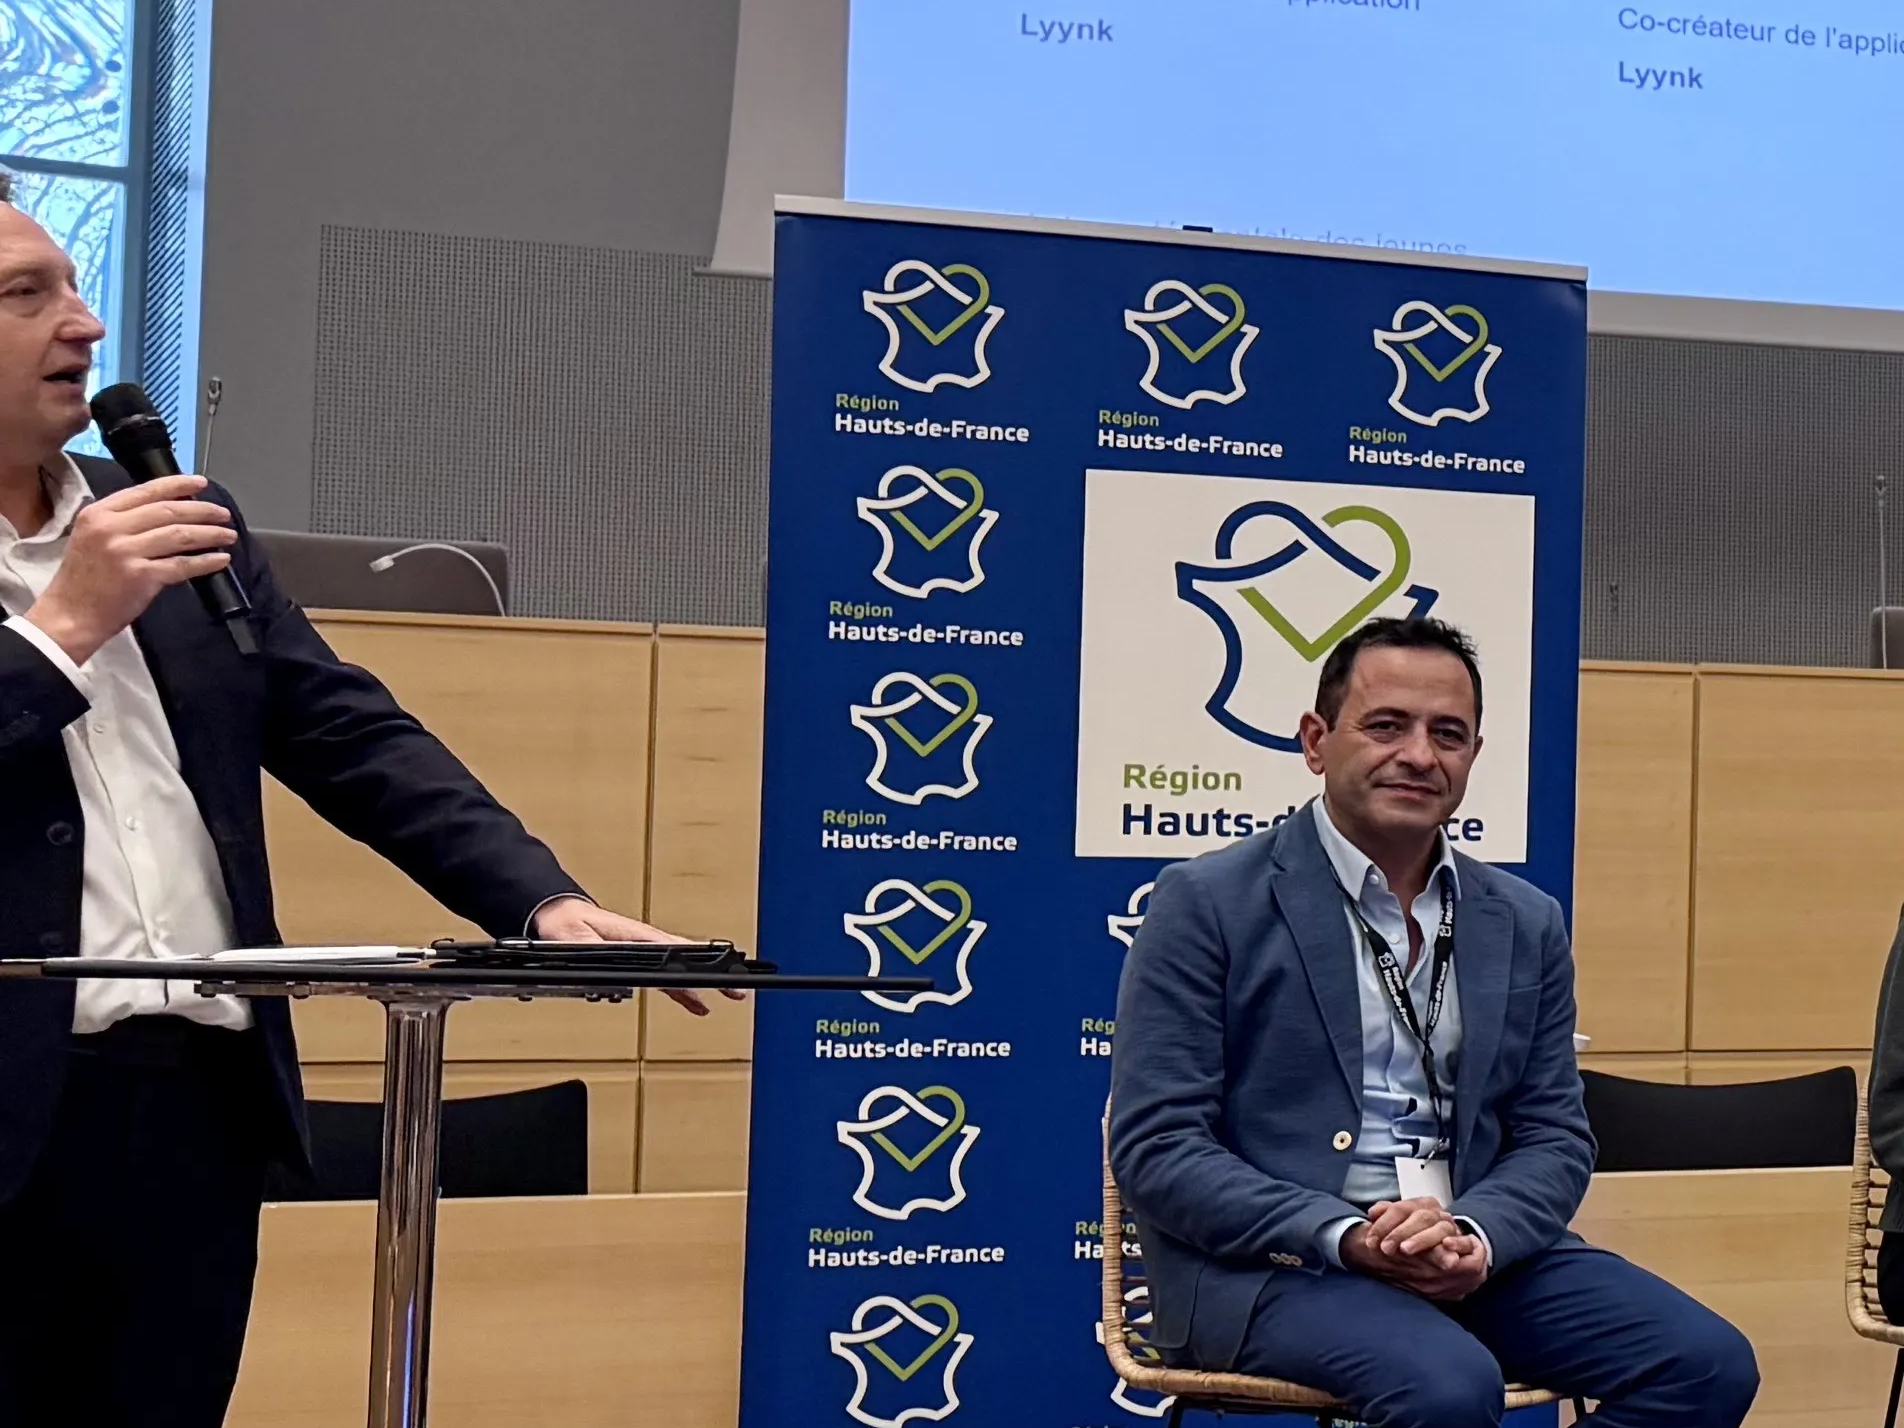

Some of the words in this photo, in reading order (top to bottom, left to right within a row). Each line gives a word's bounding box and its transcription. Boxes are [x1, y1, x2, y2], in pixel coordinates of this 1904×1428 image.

[1021, 13, 1114, 43] Lyynk
[1618, 7, 1776, 43] Co-créateur
[1785, 24, 1816, 47] de
[1618, 61, 1704, 91] Lyynk
[836, 392, 900, 412] Région
[835, 413, 1030, 443] Hauts-de-France
[1099, 409, 1160, 428] Région
[1098, 429, 1284, 459] Hauts-de-France
[1350, 426, 1407, 445] Région
[1349, 445, 1526, 475] Hauts-de-France
[830, 600, 893, 619] Région
[828, 620, 1024, 647] Hauts-de-France
[1123, 763, 1242, 796] Région
[823, 809, 886, 828] Région
[1122, 803, 1485, 842] Hauts-ce
[821, 829, 1018, 852] Hauts-de-France
[816, 1019, 880, 1036] Région
[1081, 1017, 1116, 1035] Rég
[815, 1038, 1011, 1059] Hauts-de-France
[809, 1227, 873, 1245] Région
[808, 1245, 1005, 1268] Hauts-de-France
